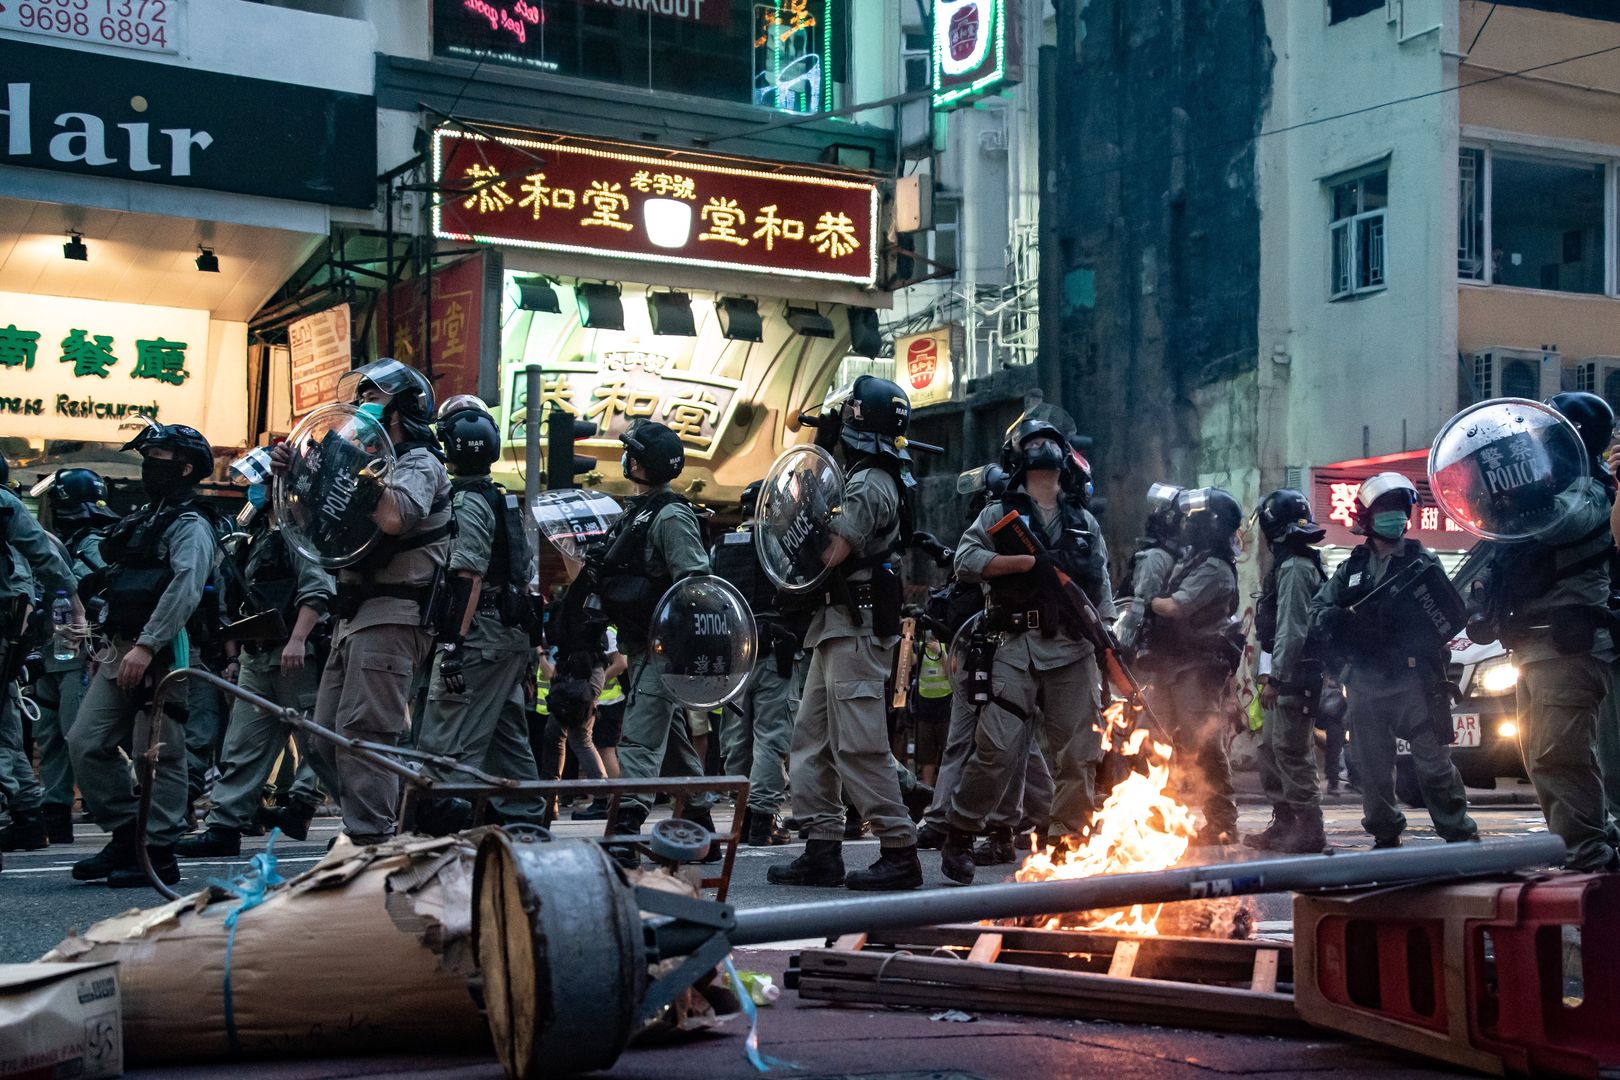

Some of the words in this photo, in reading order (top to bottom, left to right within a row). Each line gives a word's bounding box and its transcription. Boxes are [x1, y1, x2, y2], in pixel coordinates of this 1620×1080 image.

[18, 3, 89, 36] 9698
[99, 16, 167, 48] 6894
[464, 164, 634, 232] 恭和堂
[630, 170, 697, 201] 老字號
[895, 407, 908, 417] MAR
[897, 418, 903, 426] 2
[1480, 438, 1532, 470] 警察
[321, 467, 360, 521] POLICE
[1486, 458, 1542, 494] POLICE
[555, 499, 587, 543] POLICE
[781, 509, 815, 555] POLICE
[694, 613, 728, 635] POLICE
[1420, 592, 1447, 629] POLICE
